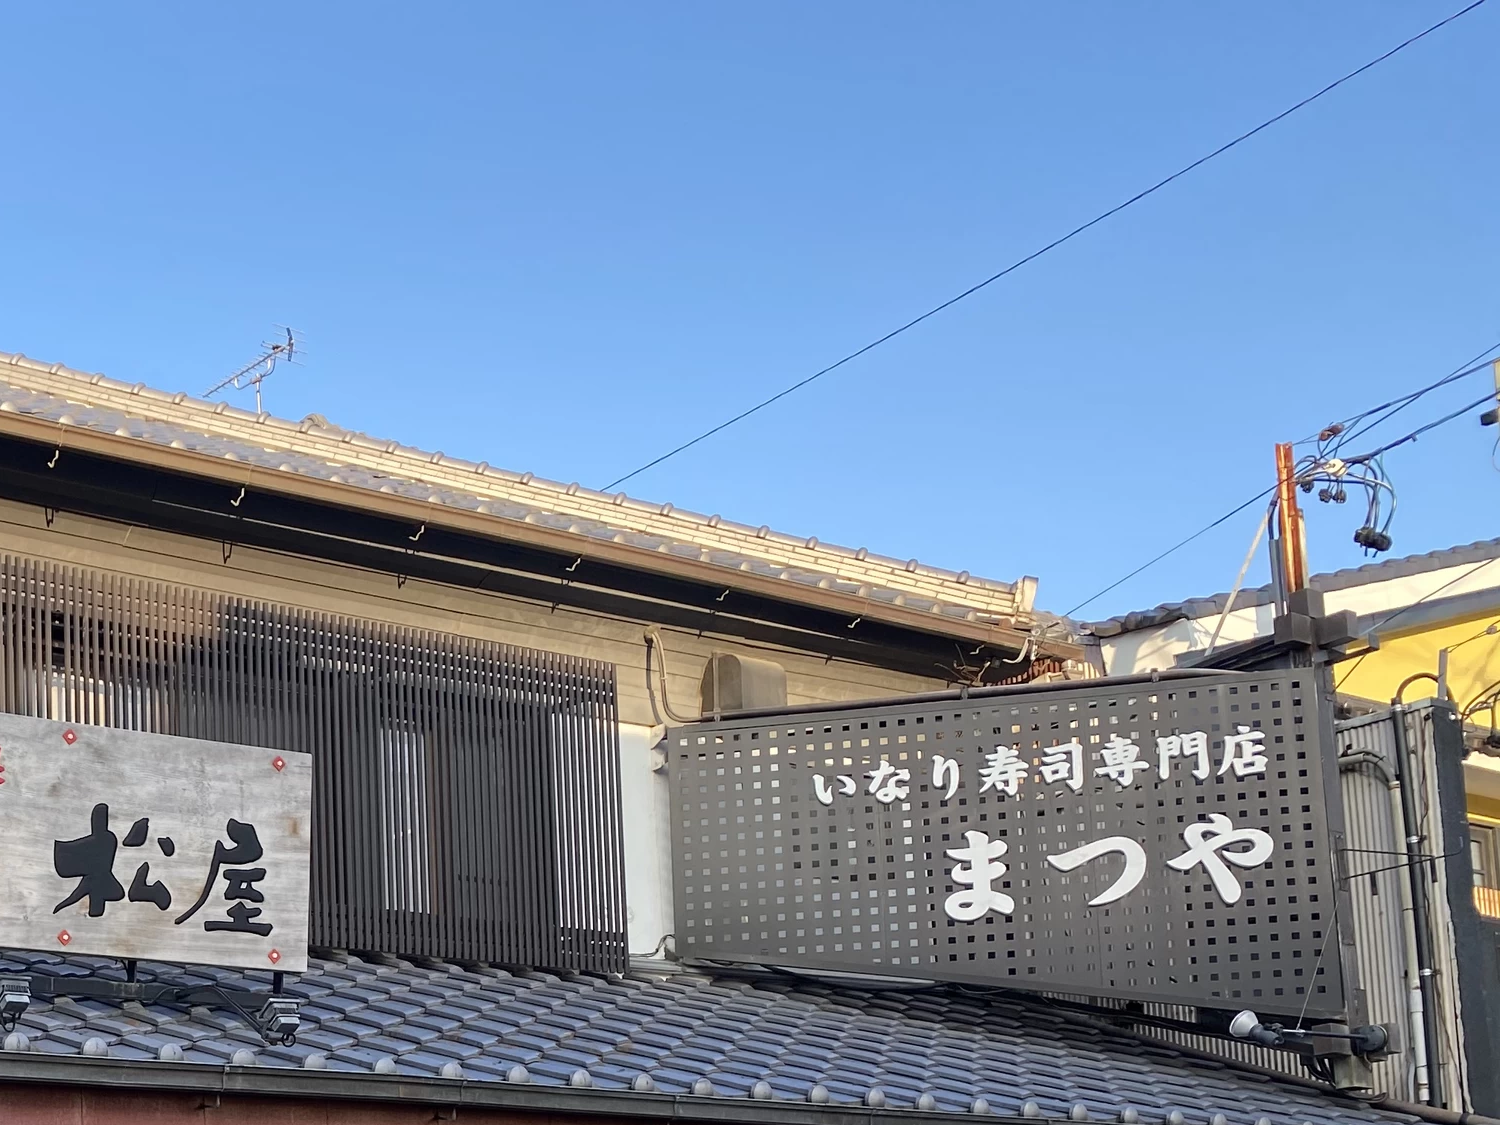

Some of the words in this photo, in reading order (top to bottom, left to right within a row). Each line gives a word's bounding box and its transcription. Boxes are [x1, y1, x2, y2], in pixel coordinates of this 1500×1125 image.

[811, 724, 1270, 806] いなり寿司専門店
[52, 802, 273, 938] 松屋
[943, 812, 1275, 923] まつや
